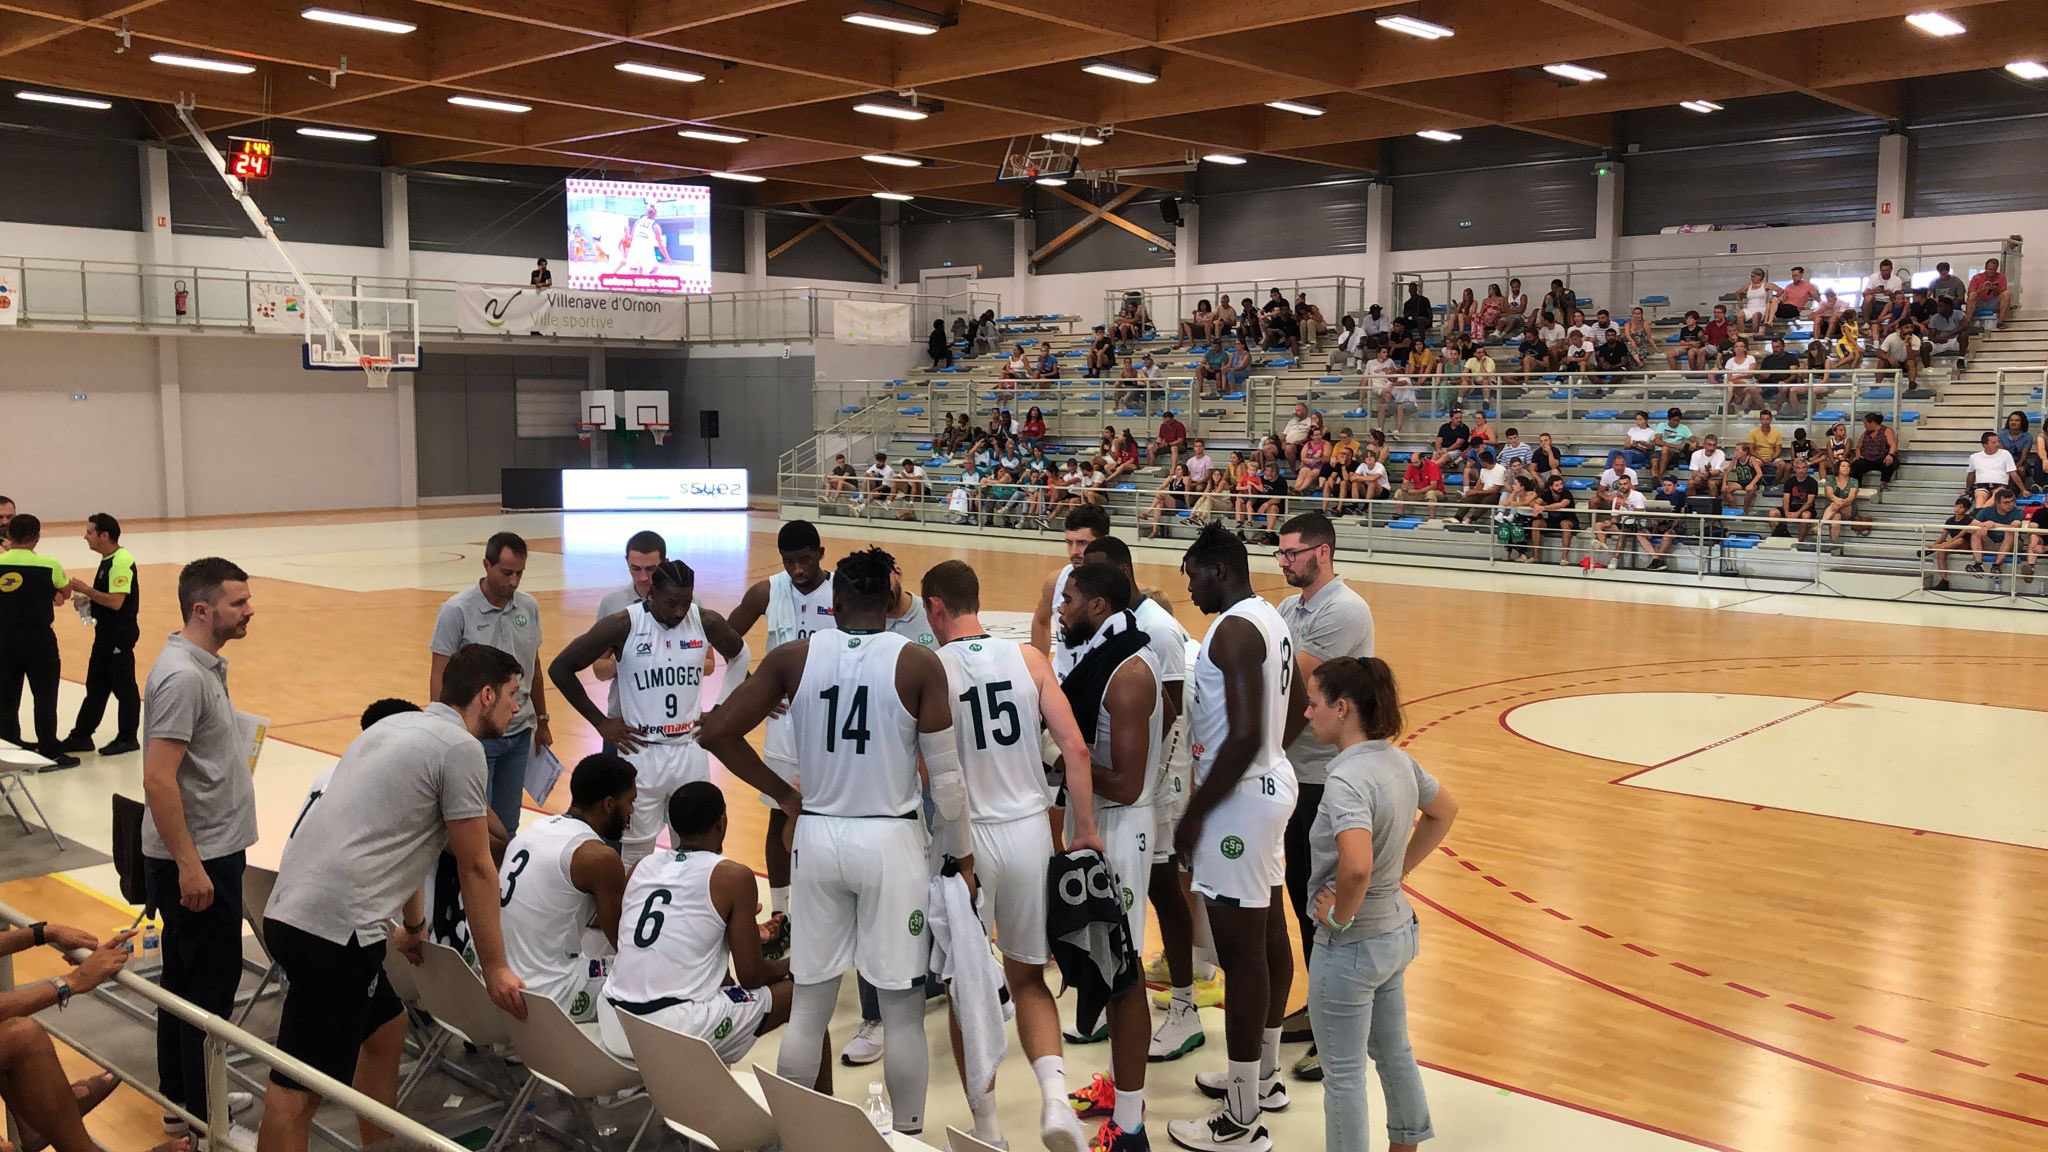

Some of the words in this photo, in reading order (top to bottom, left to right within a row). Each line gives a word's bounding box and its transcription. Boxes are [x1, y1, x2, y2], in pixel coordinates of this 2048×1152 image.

[236, 154, 262, 174] 24
[547, 293, 607, 310] Villenave
[611, 296, 662, 313] d'Ornon
[529, 311, 558, 327] Ville
[563, 312, 614, 329] sportive
[634, 666, 701, 690] LIMOGES
[665, 693, 677, 718] 9
[959, 680, 1021, 750] 15
[819, 684, 871, 755] 14
[1259, 775, 1276, 796] 18
[1222, 840, 1243, 853] CSP
[500, 849, 530, 907] 3
[633, 888, 672, 948] 6
[910, 914, 922, 929] CSP
